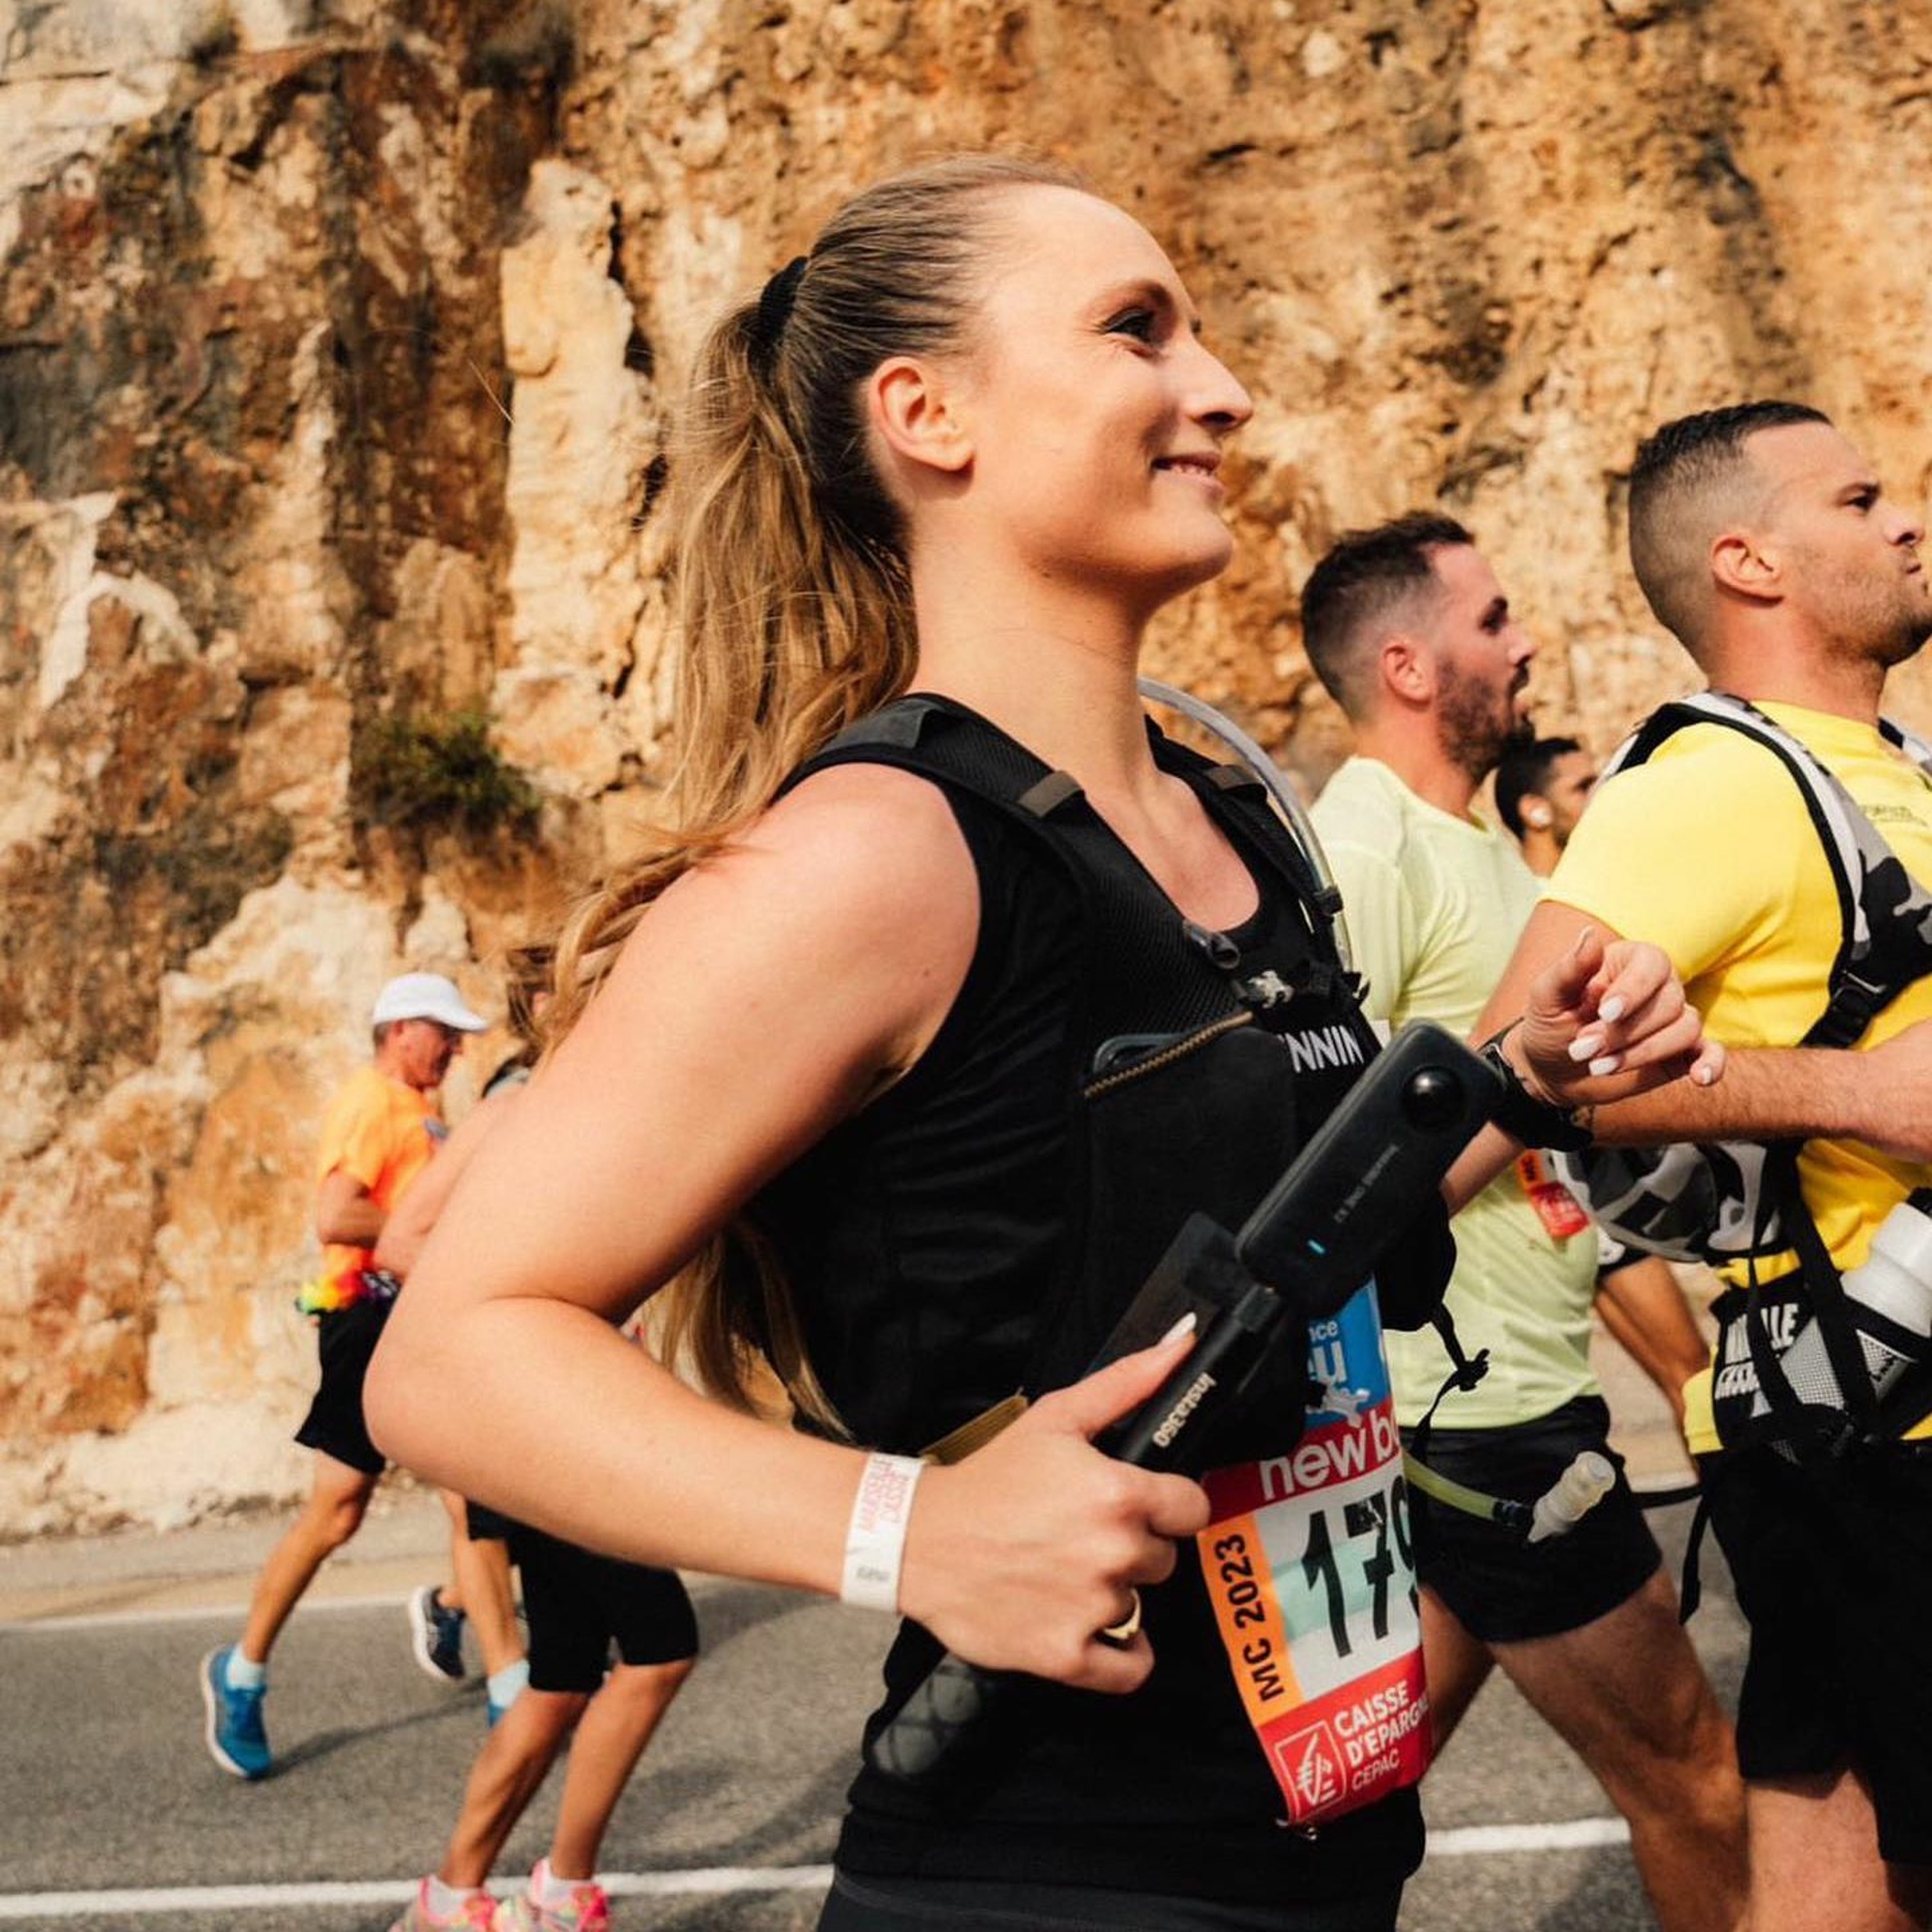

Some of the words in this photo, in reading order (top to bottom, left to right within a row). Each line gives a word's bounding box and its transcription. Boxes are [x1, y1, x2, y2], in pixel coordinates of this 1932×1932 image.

[1152, 1372, 1217, 1448] Insta360
[1258, 1427, 1367, 1502] new
[1213, 1534, 1266, 1629] 2023
[1242, 1637, 1285, 1702] MC
[1334, 1680, 1410, 1738] CAISSE
[1352, 1747, 1400, 1791] CEPAC
